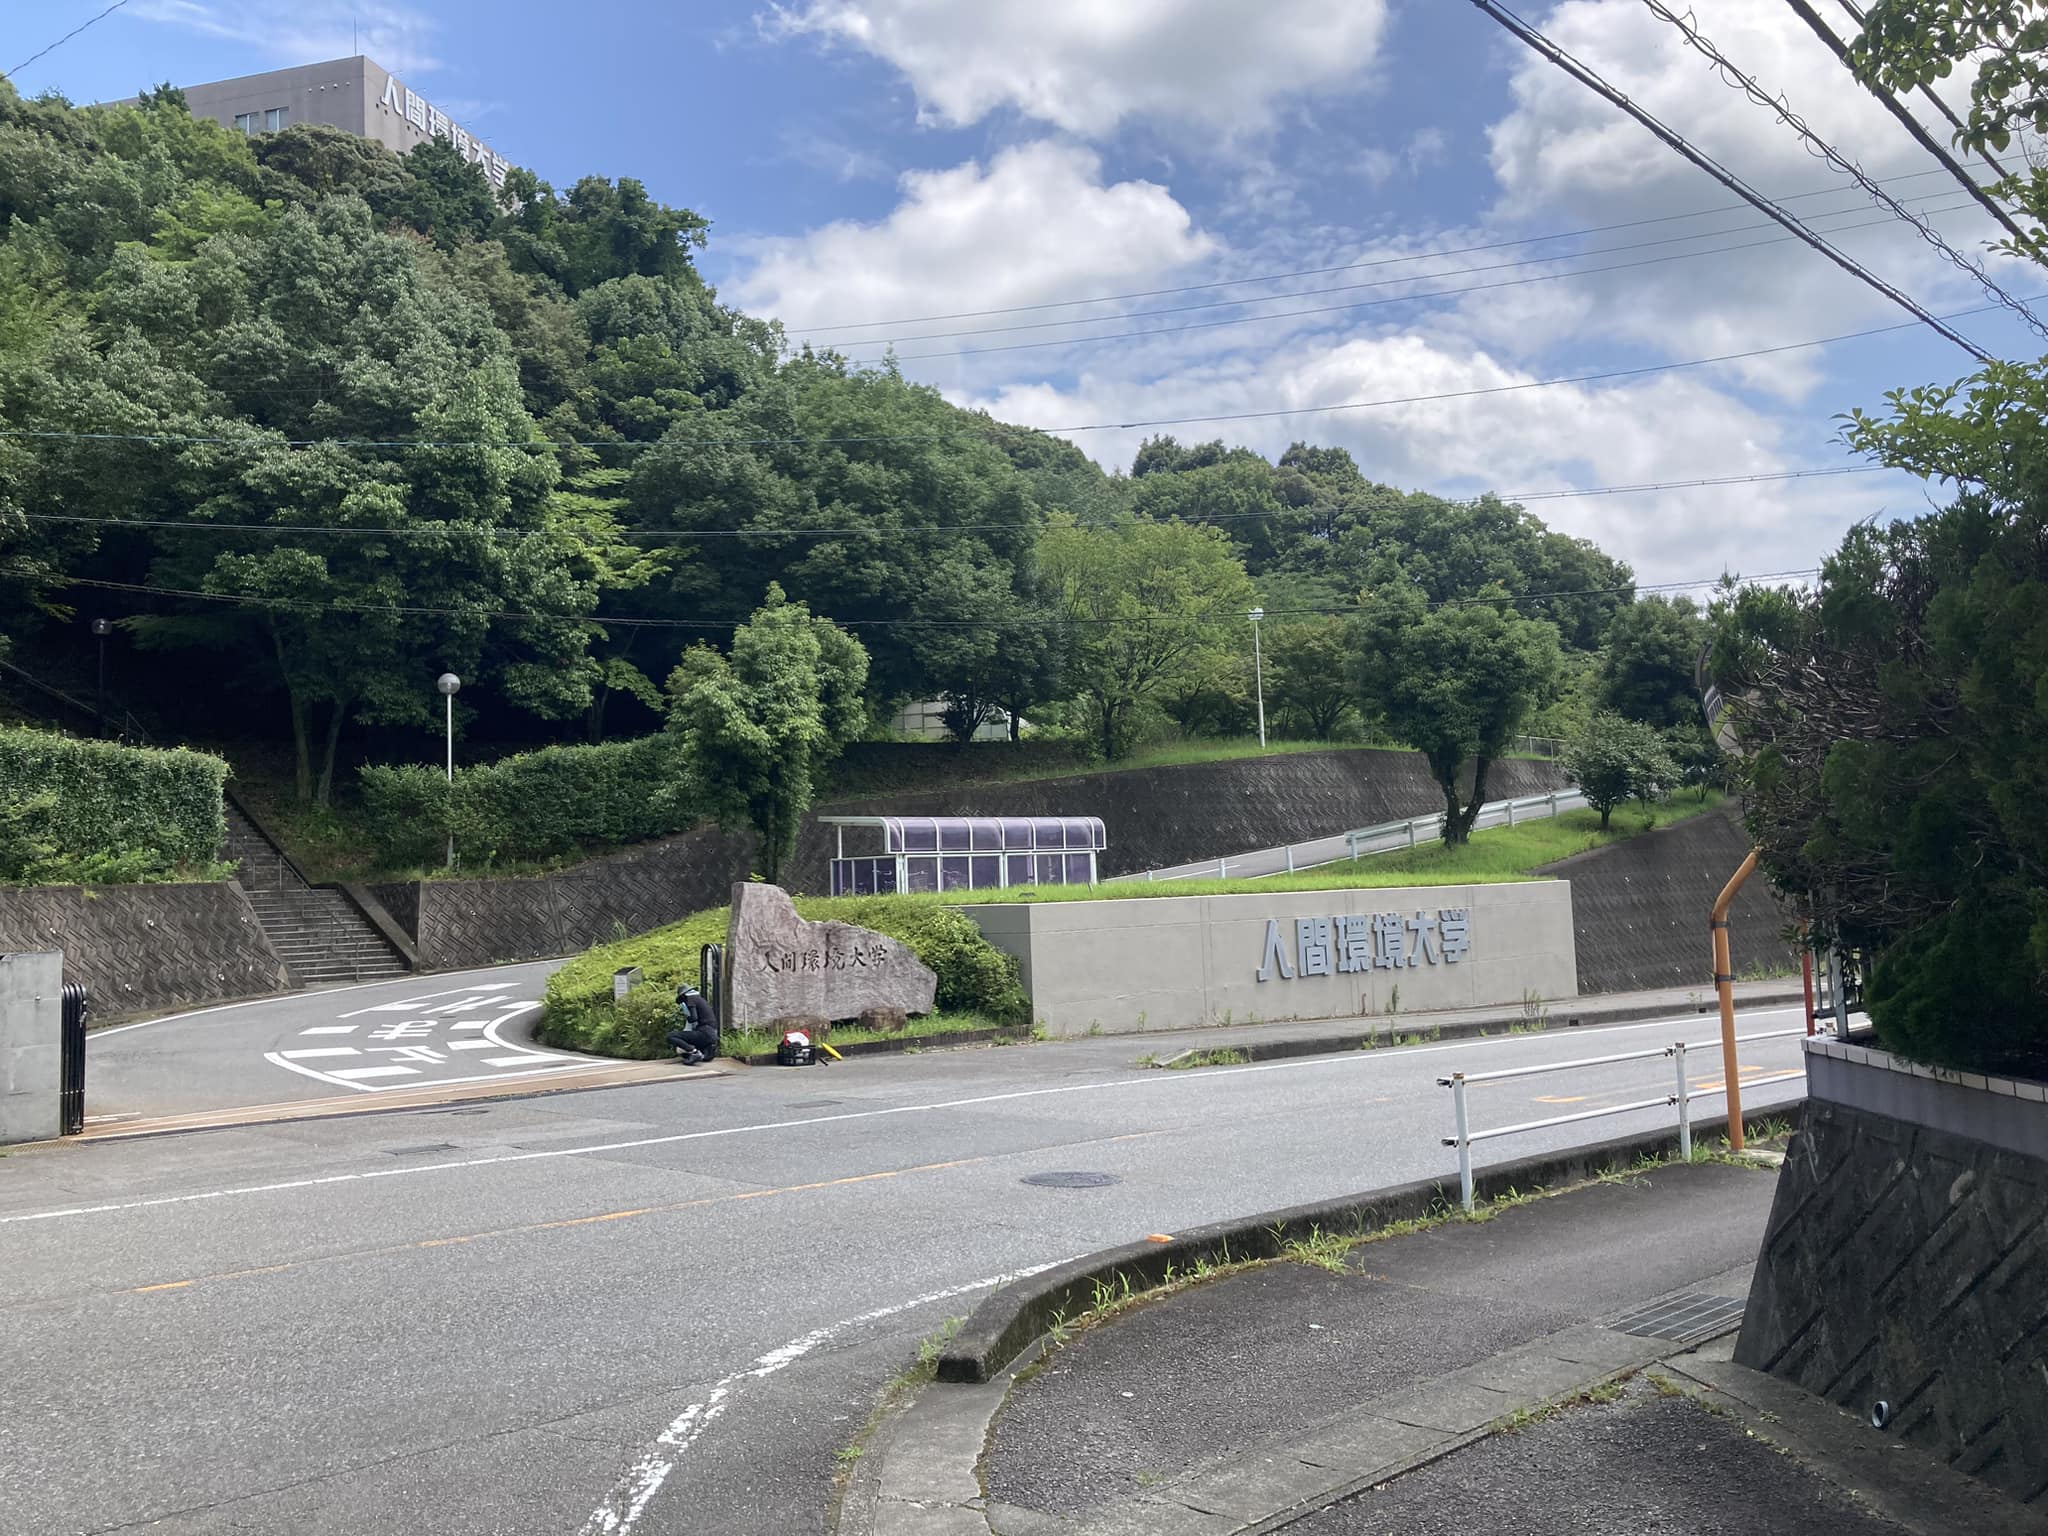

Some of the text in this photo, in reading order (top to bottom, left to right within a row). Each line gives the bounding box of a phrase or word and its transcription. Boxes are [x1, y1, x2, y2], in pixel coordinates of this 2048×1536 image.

[761, 944, 887, 972] 人間環境大学
[1257, 908, 1470, 981] 人間環境大学
